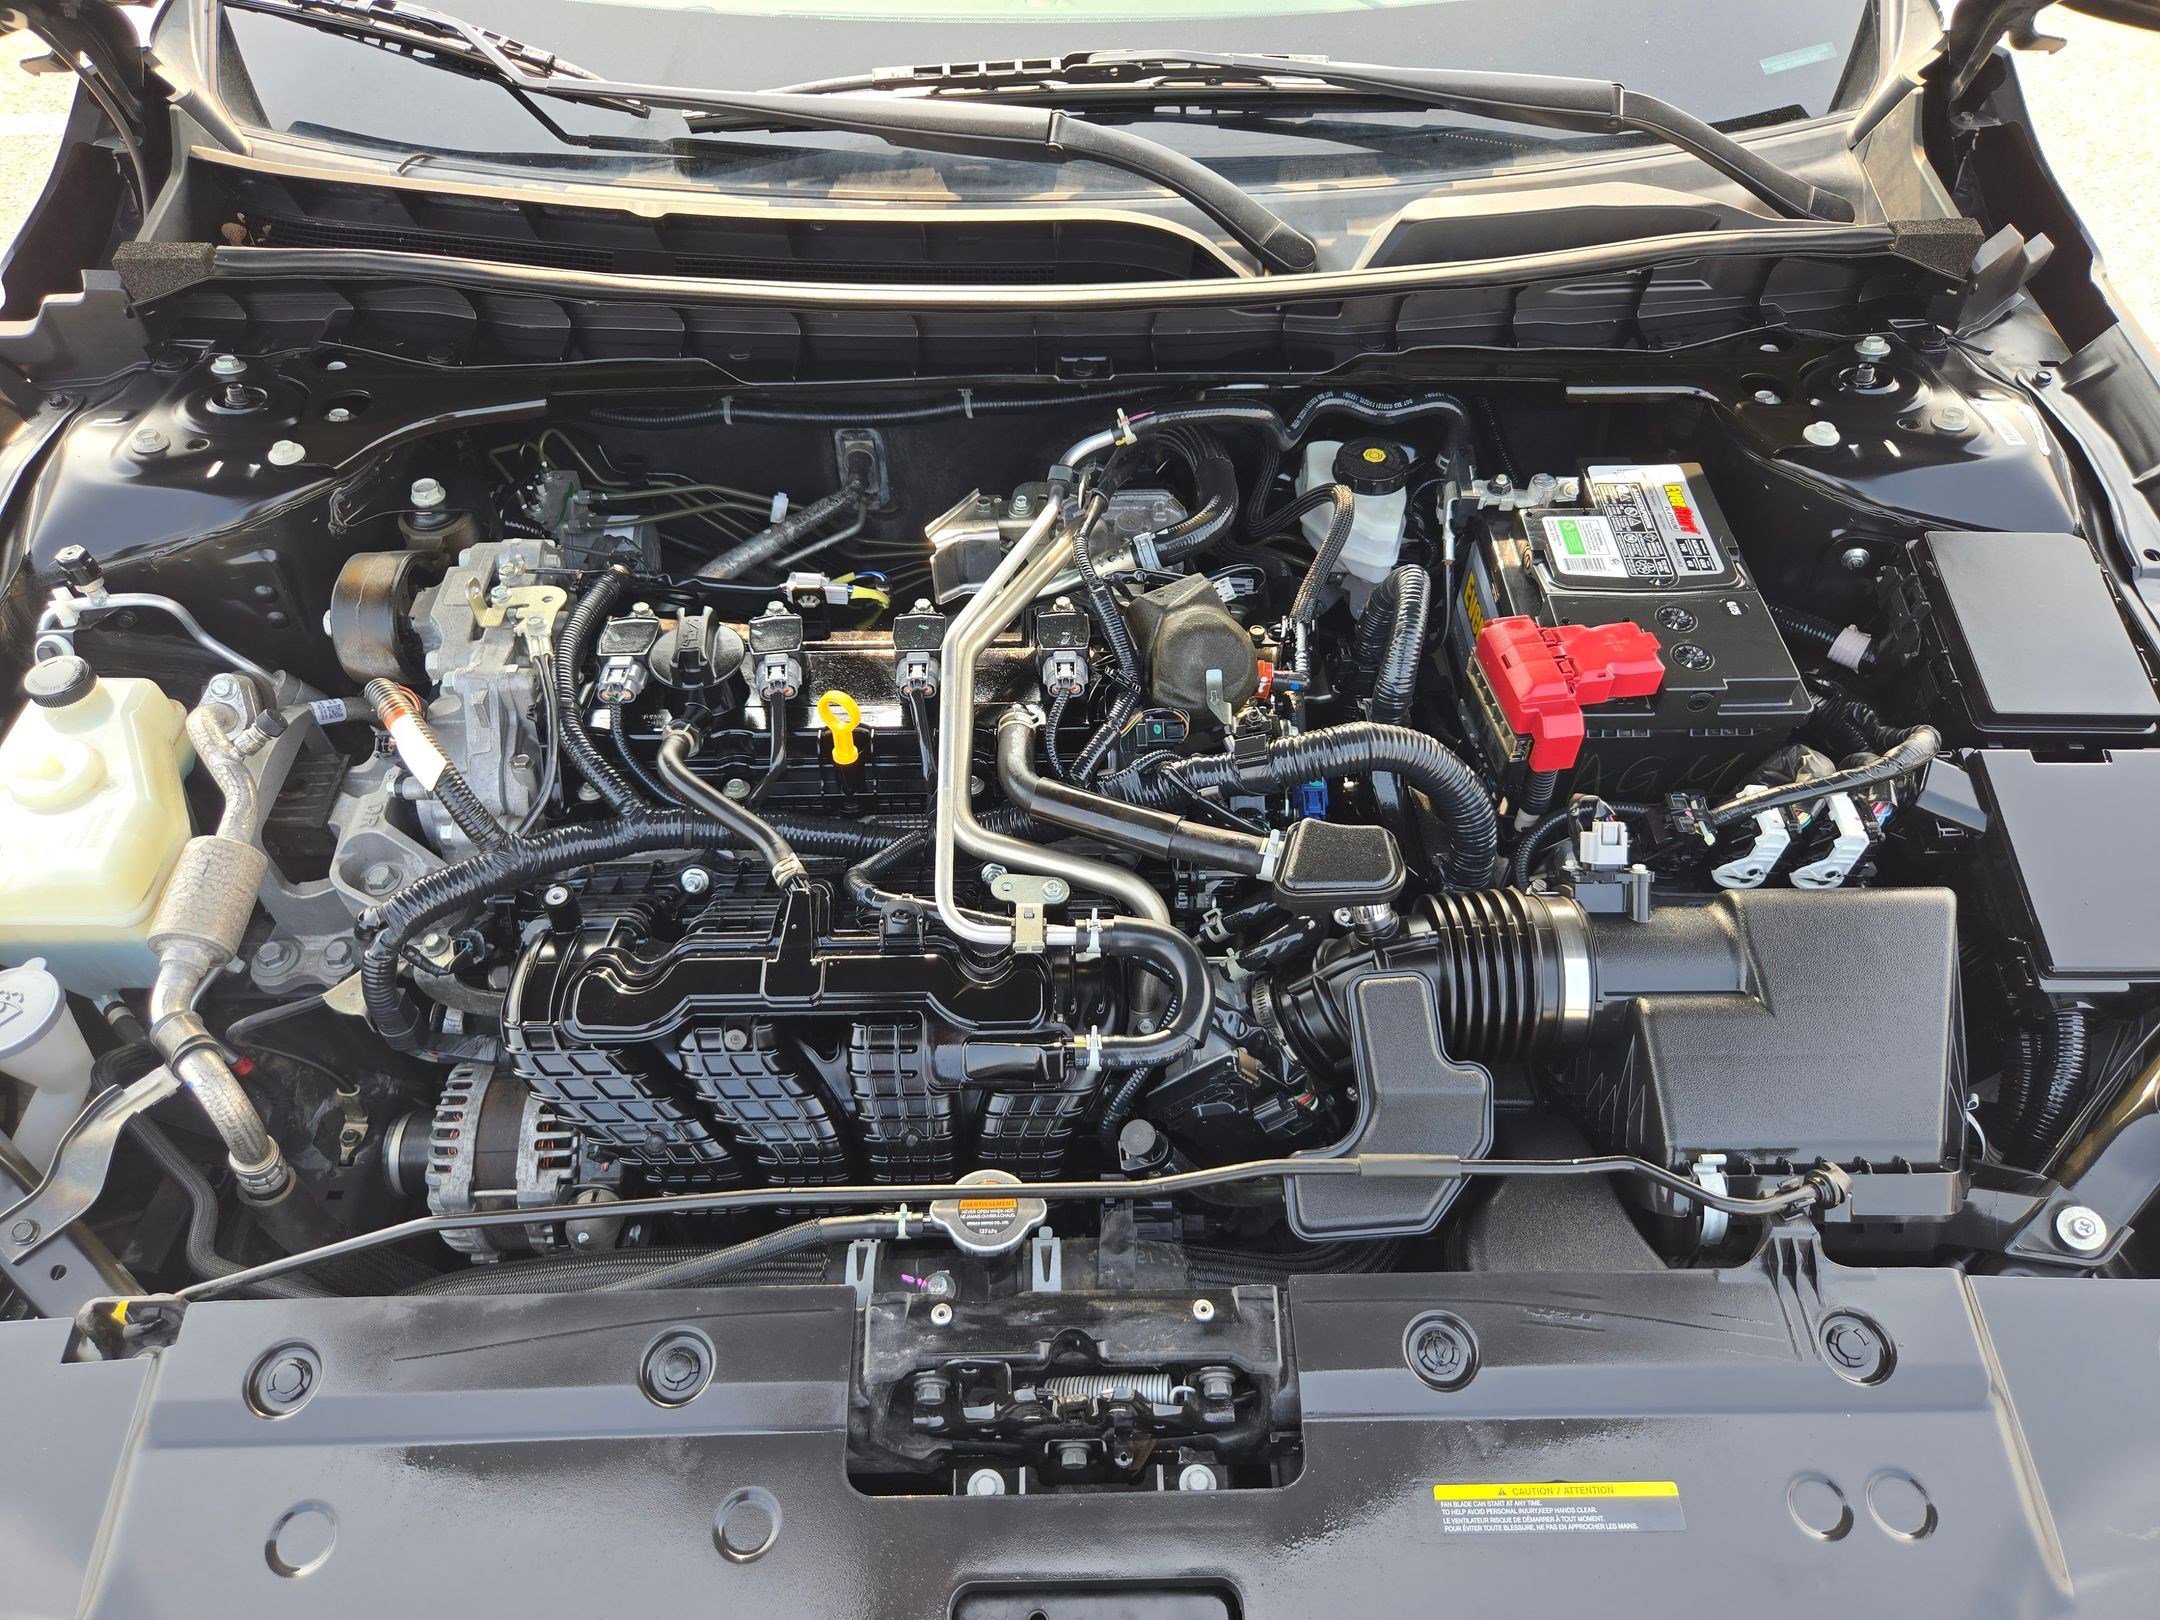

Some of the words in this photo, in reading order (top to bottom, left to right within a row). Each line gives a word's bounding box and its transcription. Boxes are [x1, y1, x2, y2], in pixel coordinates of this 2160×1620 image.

[961, 1200, 1015, 1208] AVERTISSEMENT
[1512, 1487, 1553, 1496] CAUTION
[1564, 1486, 1614, 1495] ATTENTION
[1522, 1515, 1554, 1523] DÉMARRER
[1462, 1524, 1482, 1532] ÉVITER
